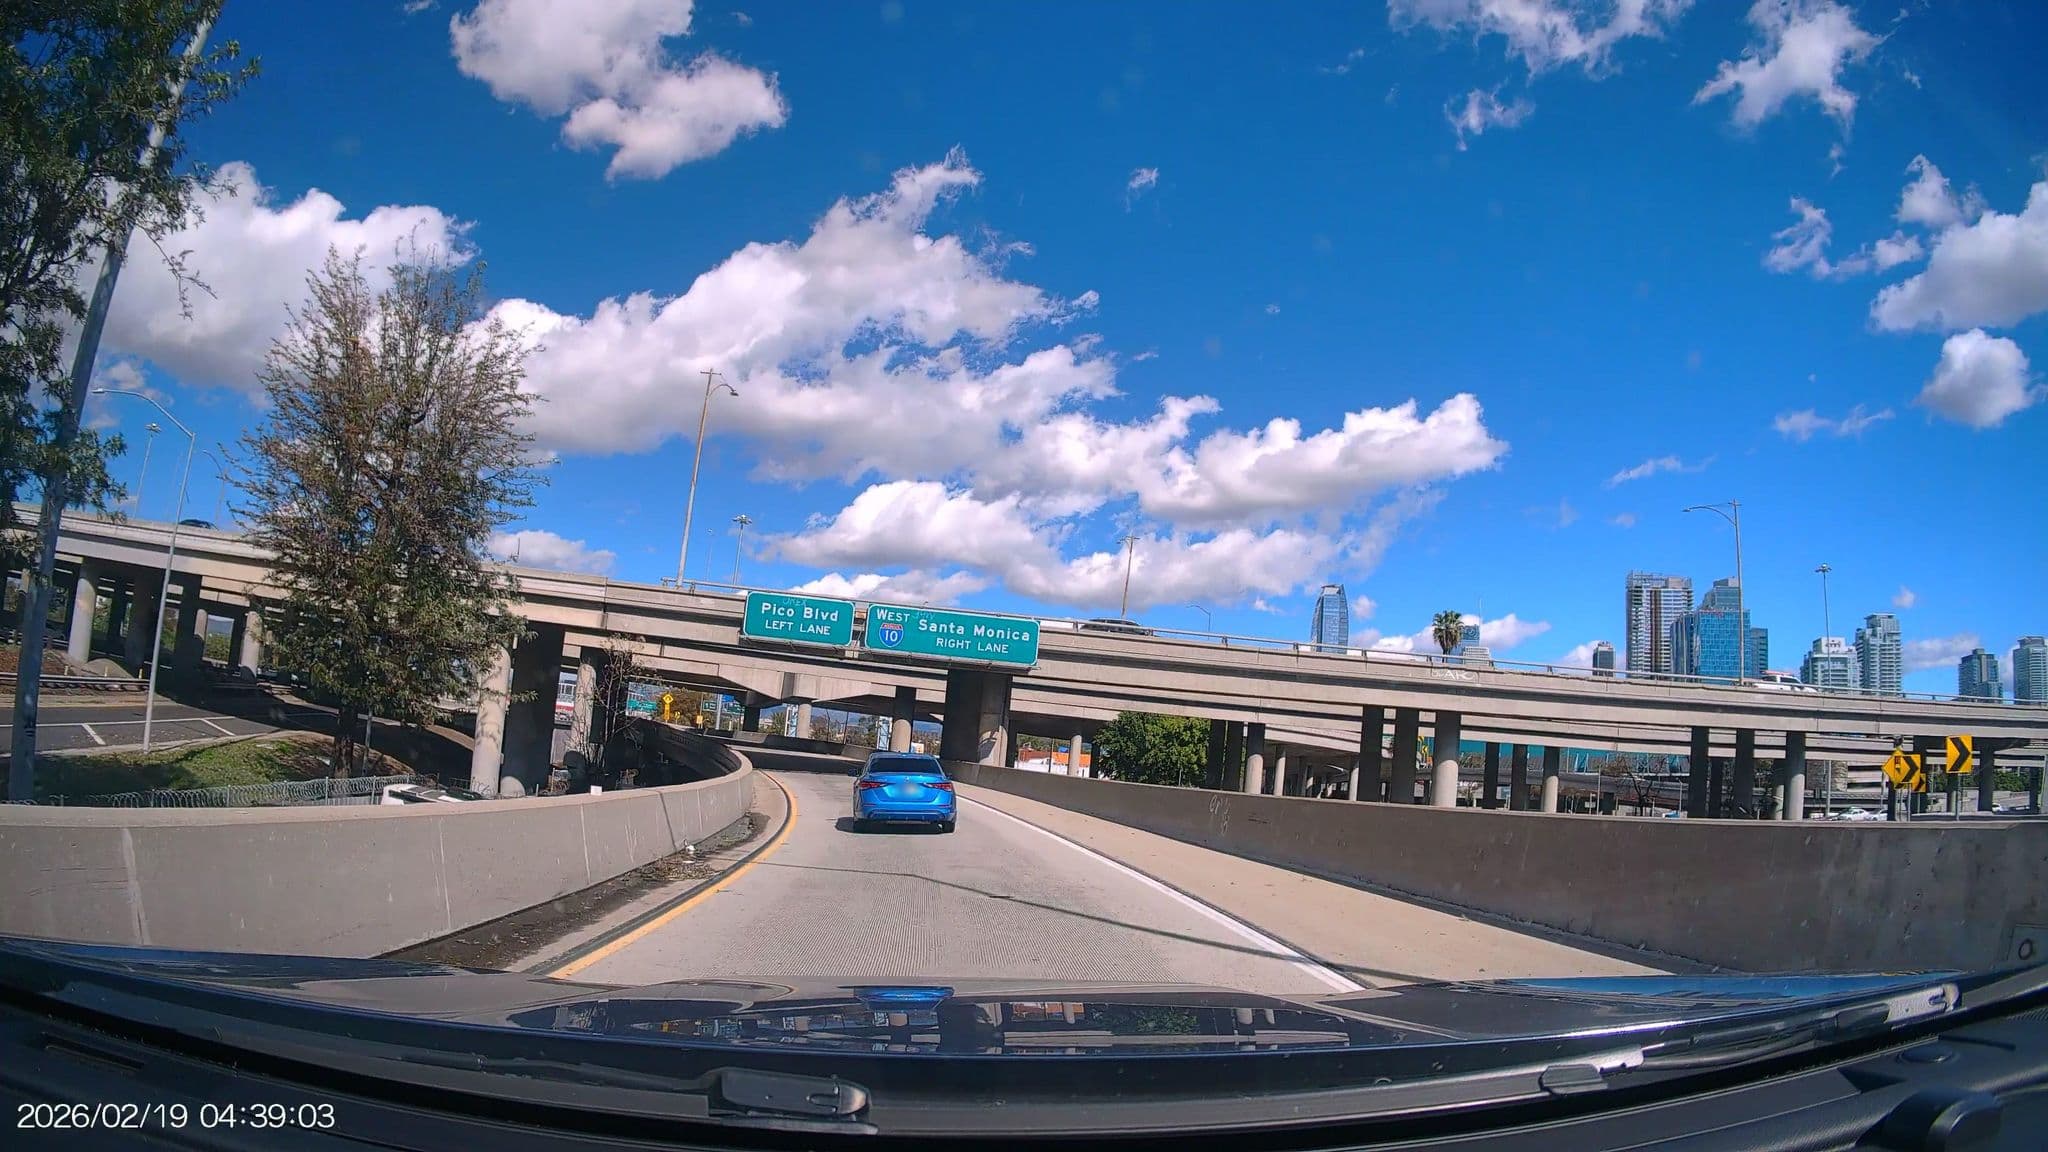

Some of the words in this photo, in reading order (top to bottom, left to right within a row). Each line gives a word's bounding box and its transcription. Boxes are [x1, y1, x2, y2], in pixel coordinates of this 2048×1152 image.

[761, 602, 795, 617] Pico
[803, 606, 839, 622] Blvd
[876, 608, 910, 622] WEST
[765, 619, 794, 631] LEFT
[800, 623, 831, 636] LANE
[885, 629, 898, 642] 10
[918, 619, 965, 636] Santa
[973, 624, 1031, 642] Monica
[936, 637, 971, 650] RIGHT
[977, 642, 1009, 654] LANE
